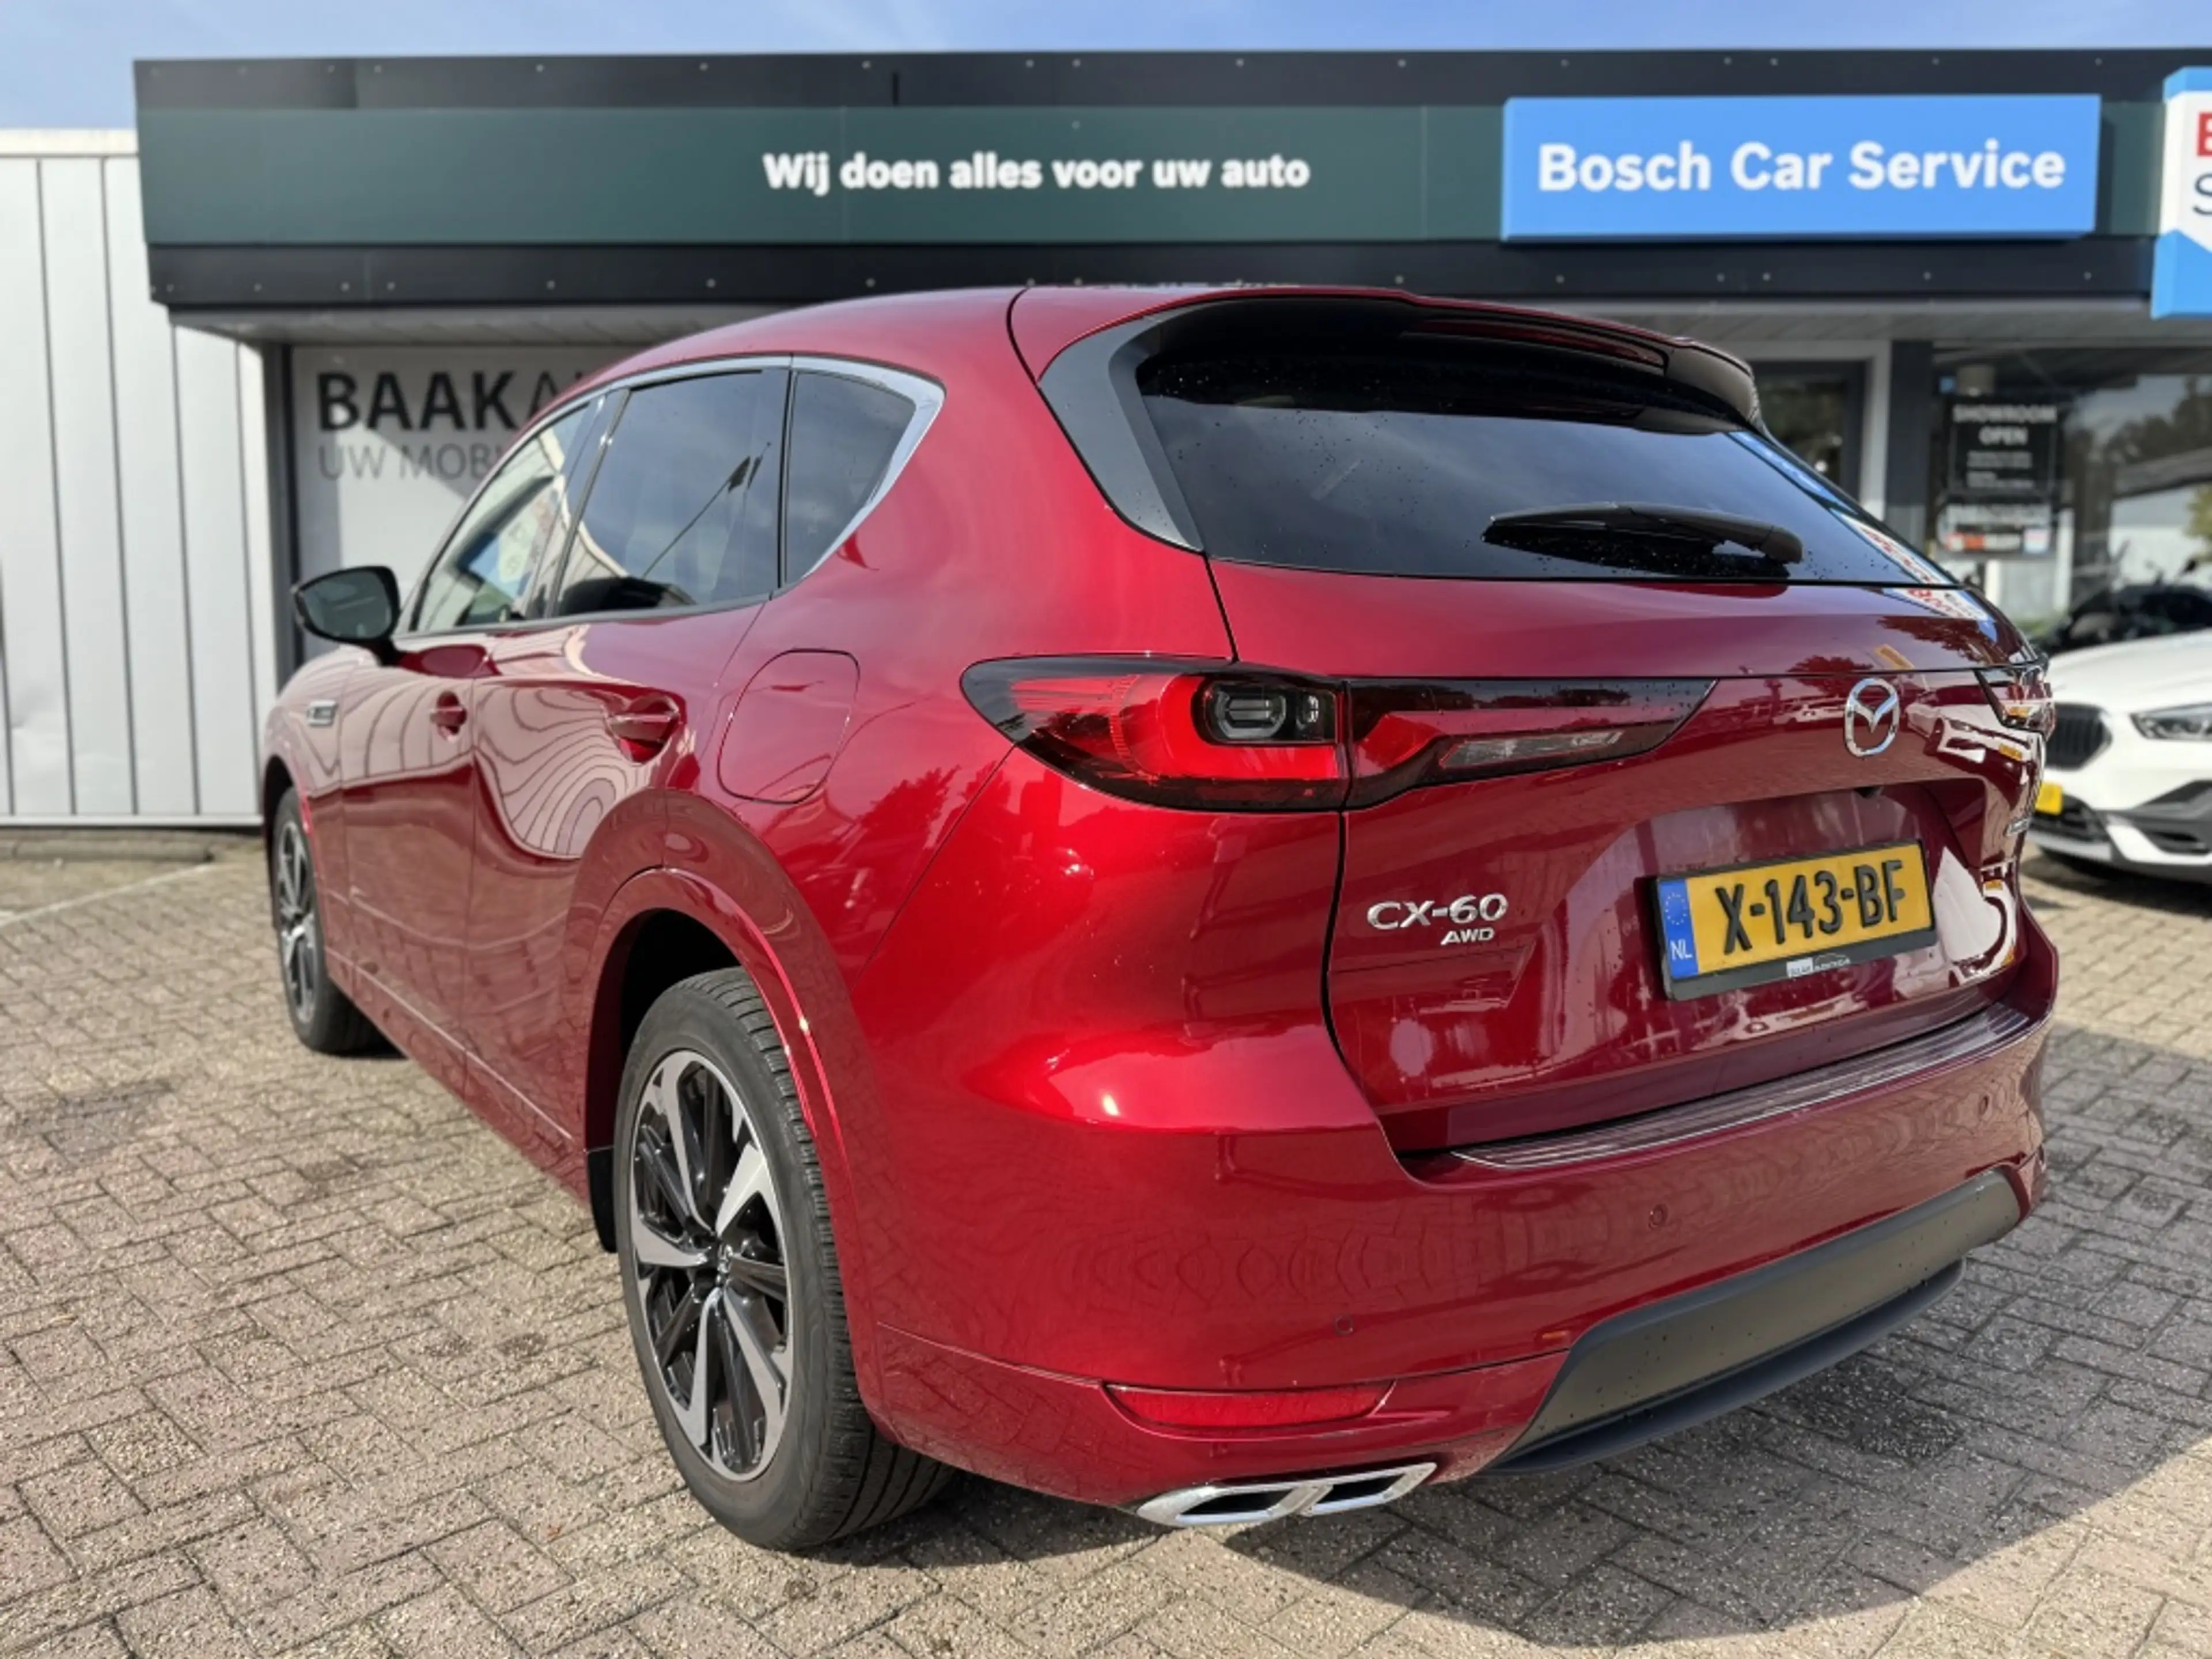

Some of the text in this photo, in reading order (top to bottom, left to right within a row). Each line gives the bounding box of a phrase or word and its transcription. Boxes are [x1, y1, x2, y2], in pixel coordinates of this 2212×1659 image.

[762, 151, 1311, 196] Wij doen alles voor uw auto
[1539, 138, 2066, 192] Bosch Car Service
[317, 444, 387, 480] UW
[1366, 893, 1509, 930] CX-60
[1714, 859, 1906, 956] X-143-BF
[1440, 926, 1495, 946] AWD
[1669, 938, 1694, 961] NL
